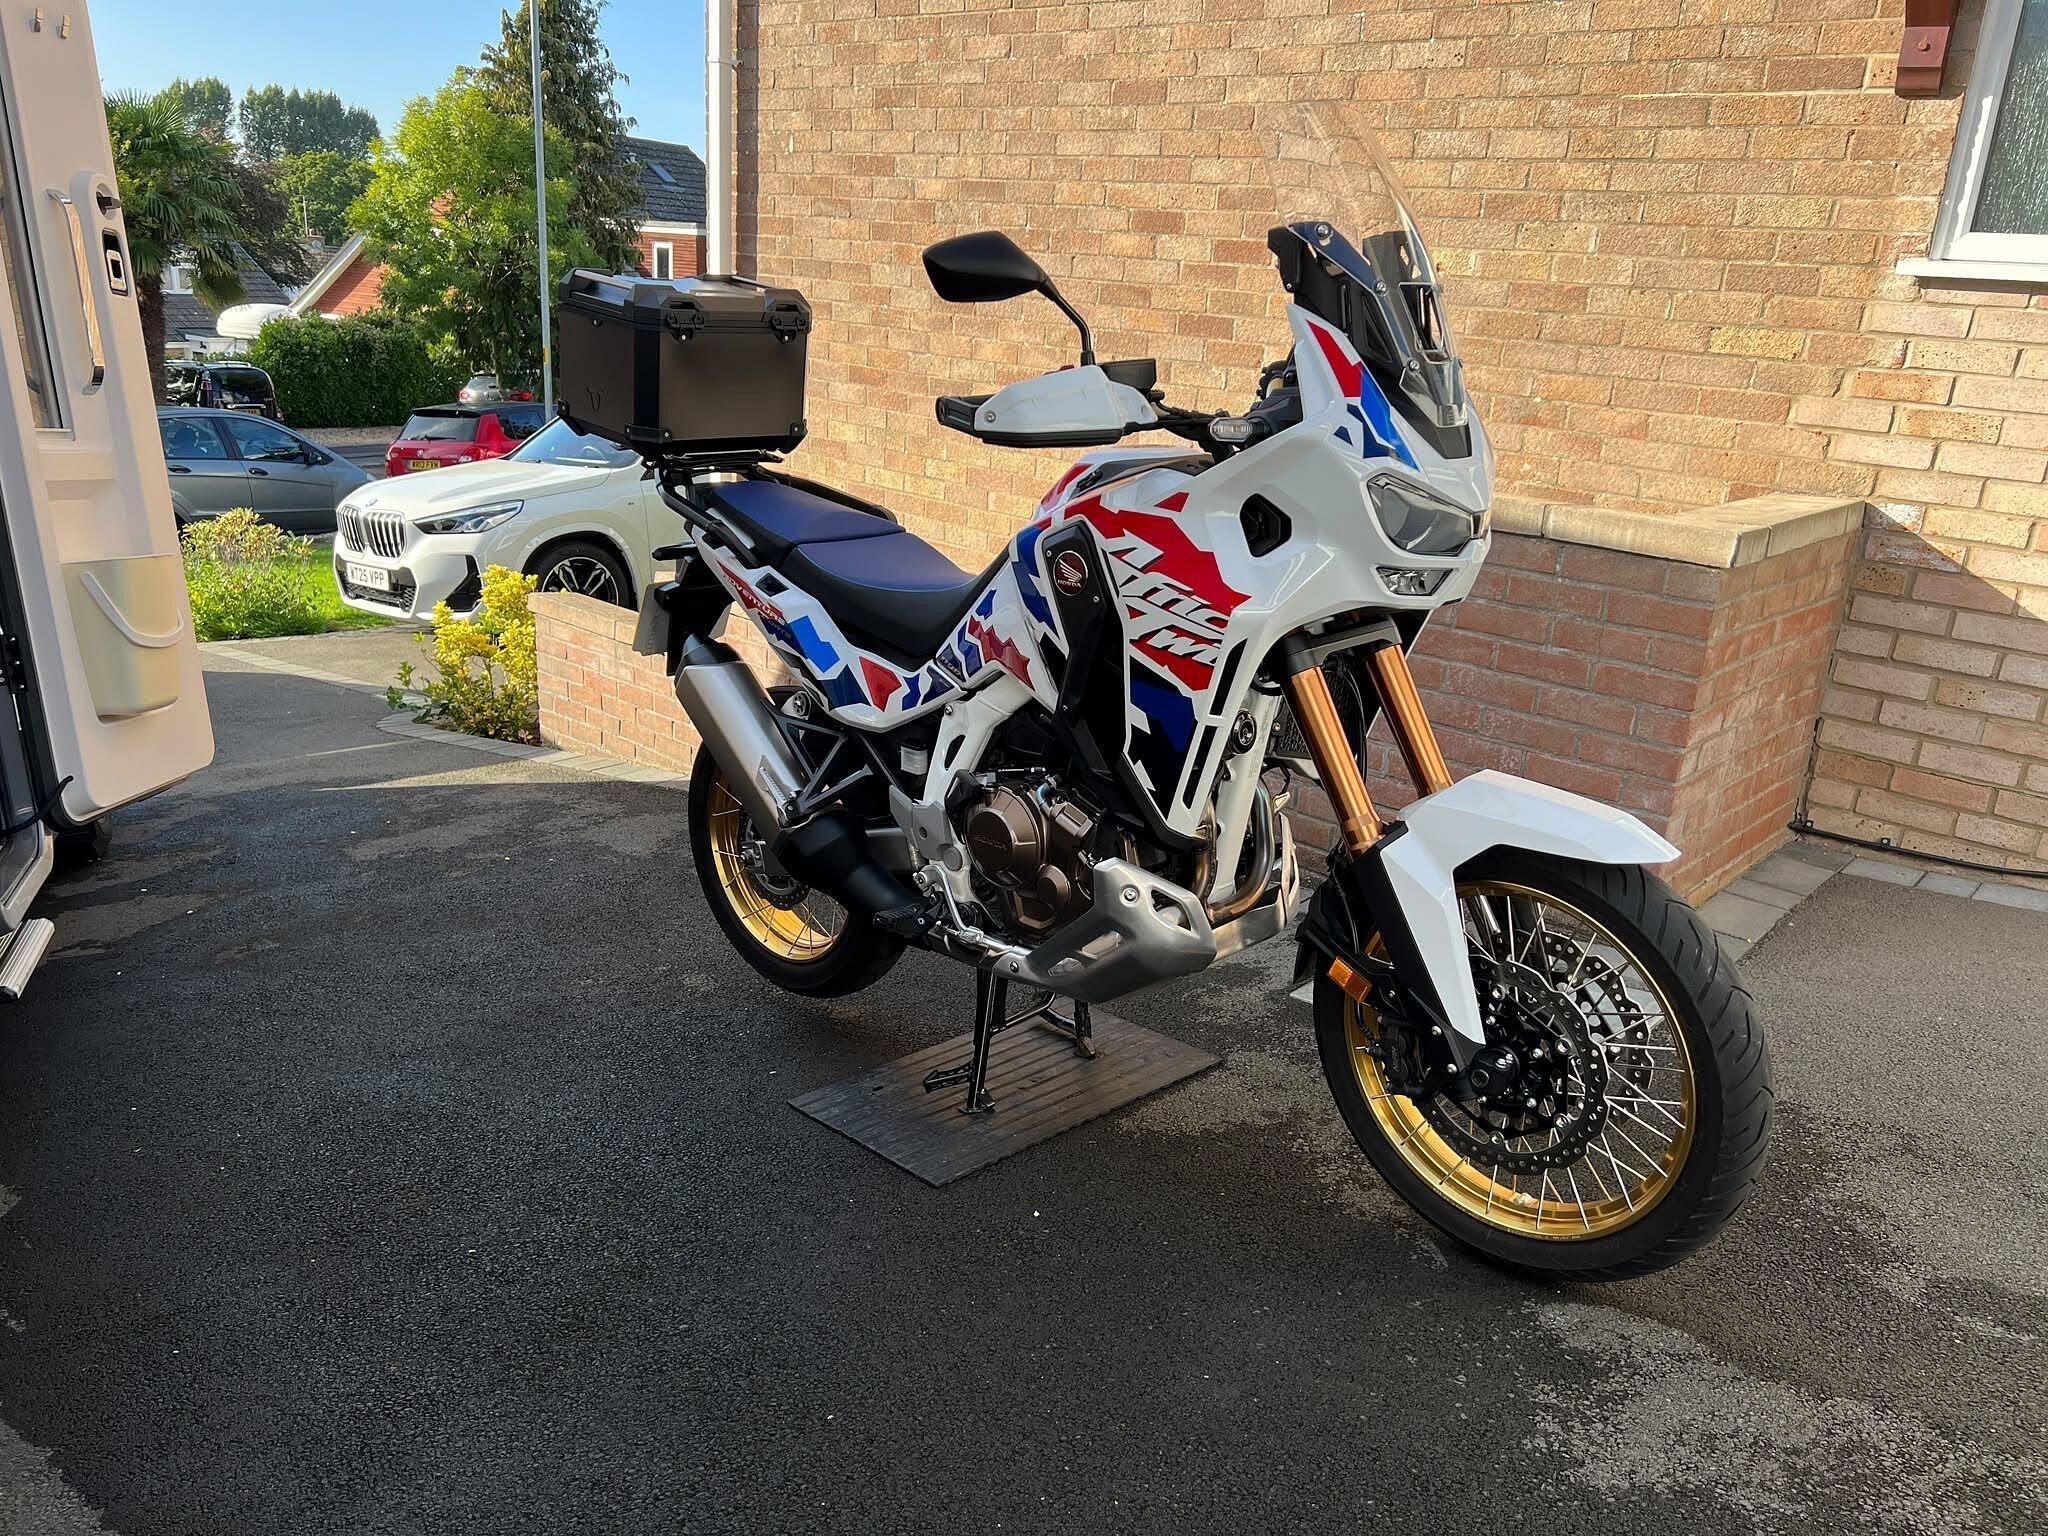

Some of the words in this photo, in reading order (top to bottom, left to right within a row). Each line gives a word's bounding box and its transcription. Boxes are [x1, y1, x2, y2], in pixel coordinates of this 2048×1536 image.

[369, 569, 384, 586] VPP
[722, 574, 787, 626] DVENTURE
[1056, 579, 1082, 589] HONDA
[1106, 528, 1230, 631] Afric
[1121, 597, 1225, 668] Twi
